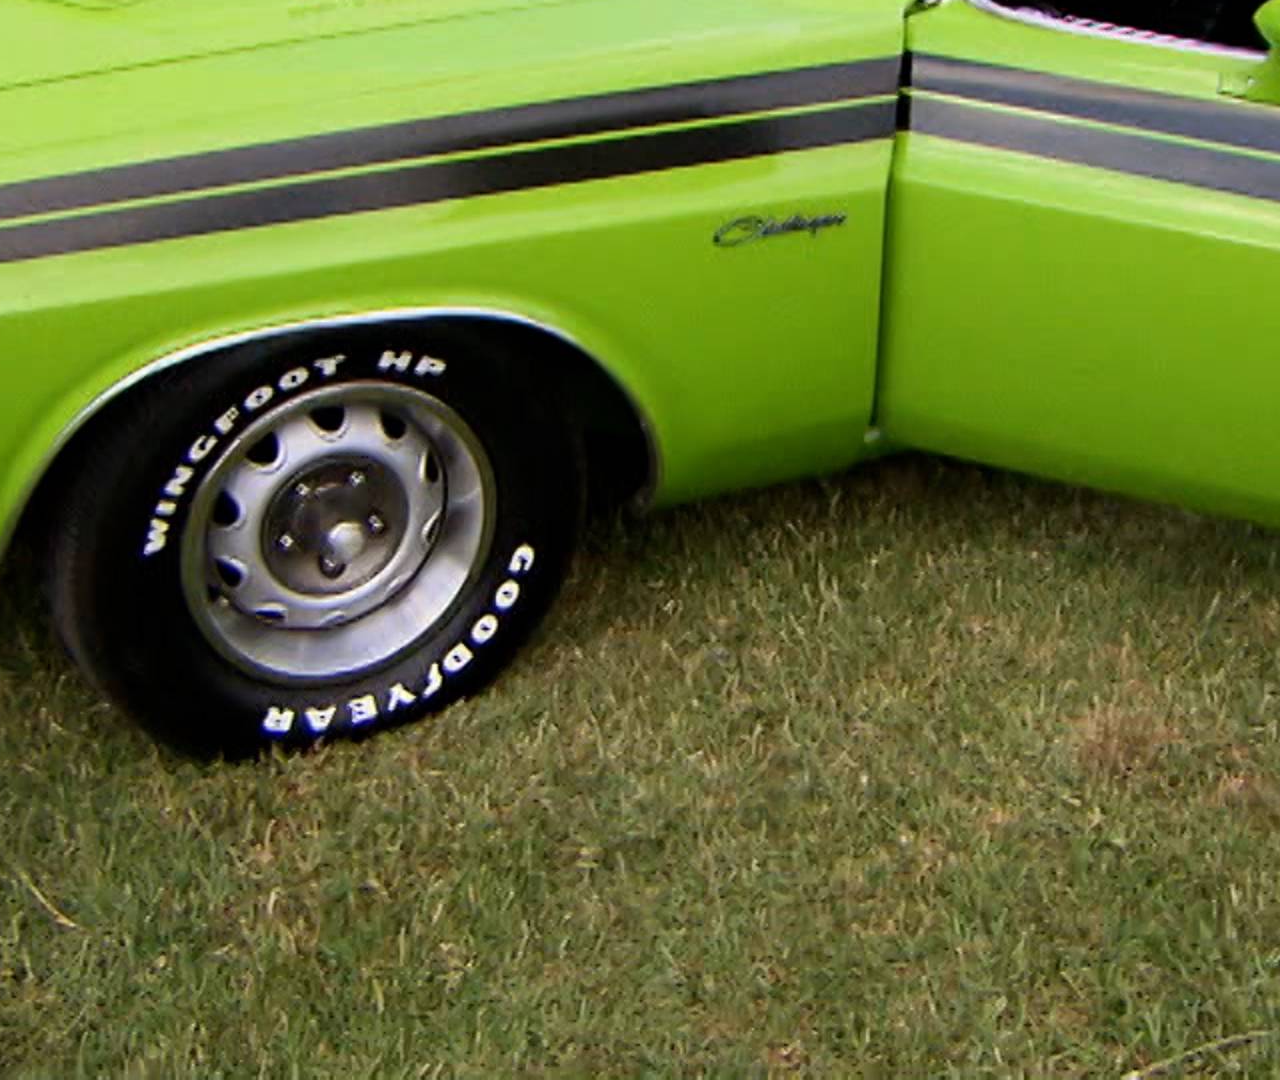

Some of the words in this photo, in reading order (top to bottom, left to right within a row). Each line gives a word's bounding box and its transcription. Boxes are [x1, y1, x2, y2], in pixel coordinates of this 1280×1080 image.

[141, 354, 345, 557] WINGFOOT
[377, 350, 448, 376] HP
[262, 543, 536, 736] GOODYEAR
